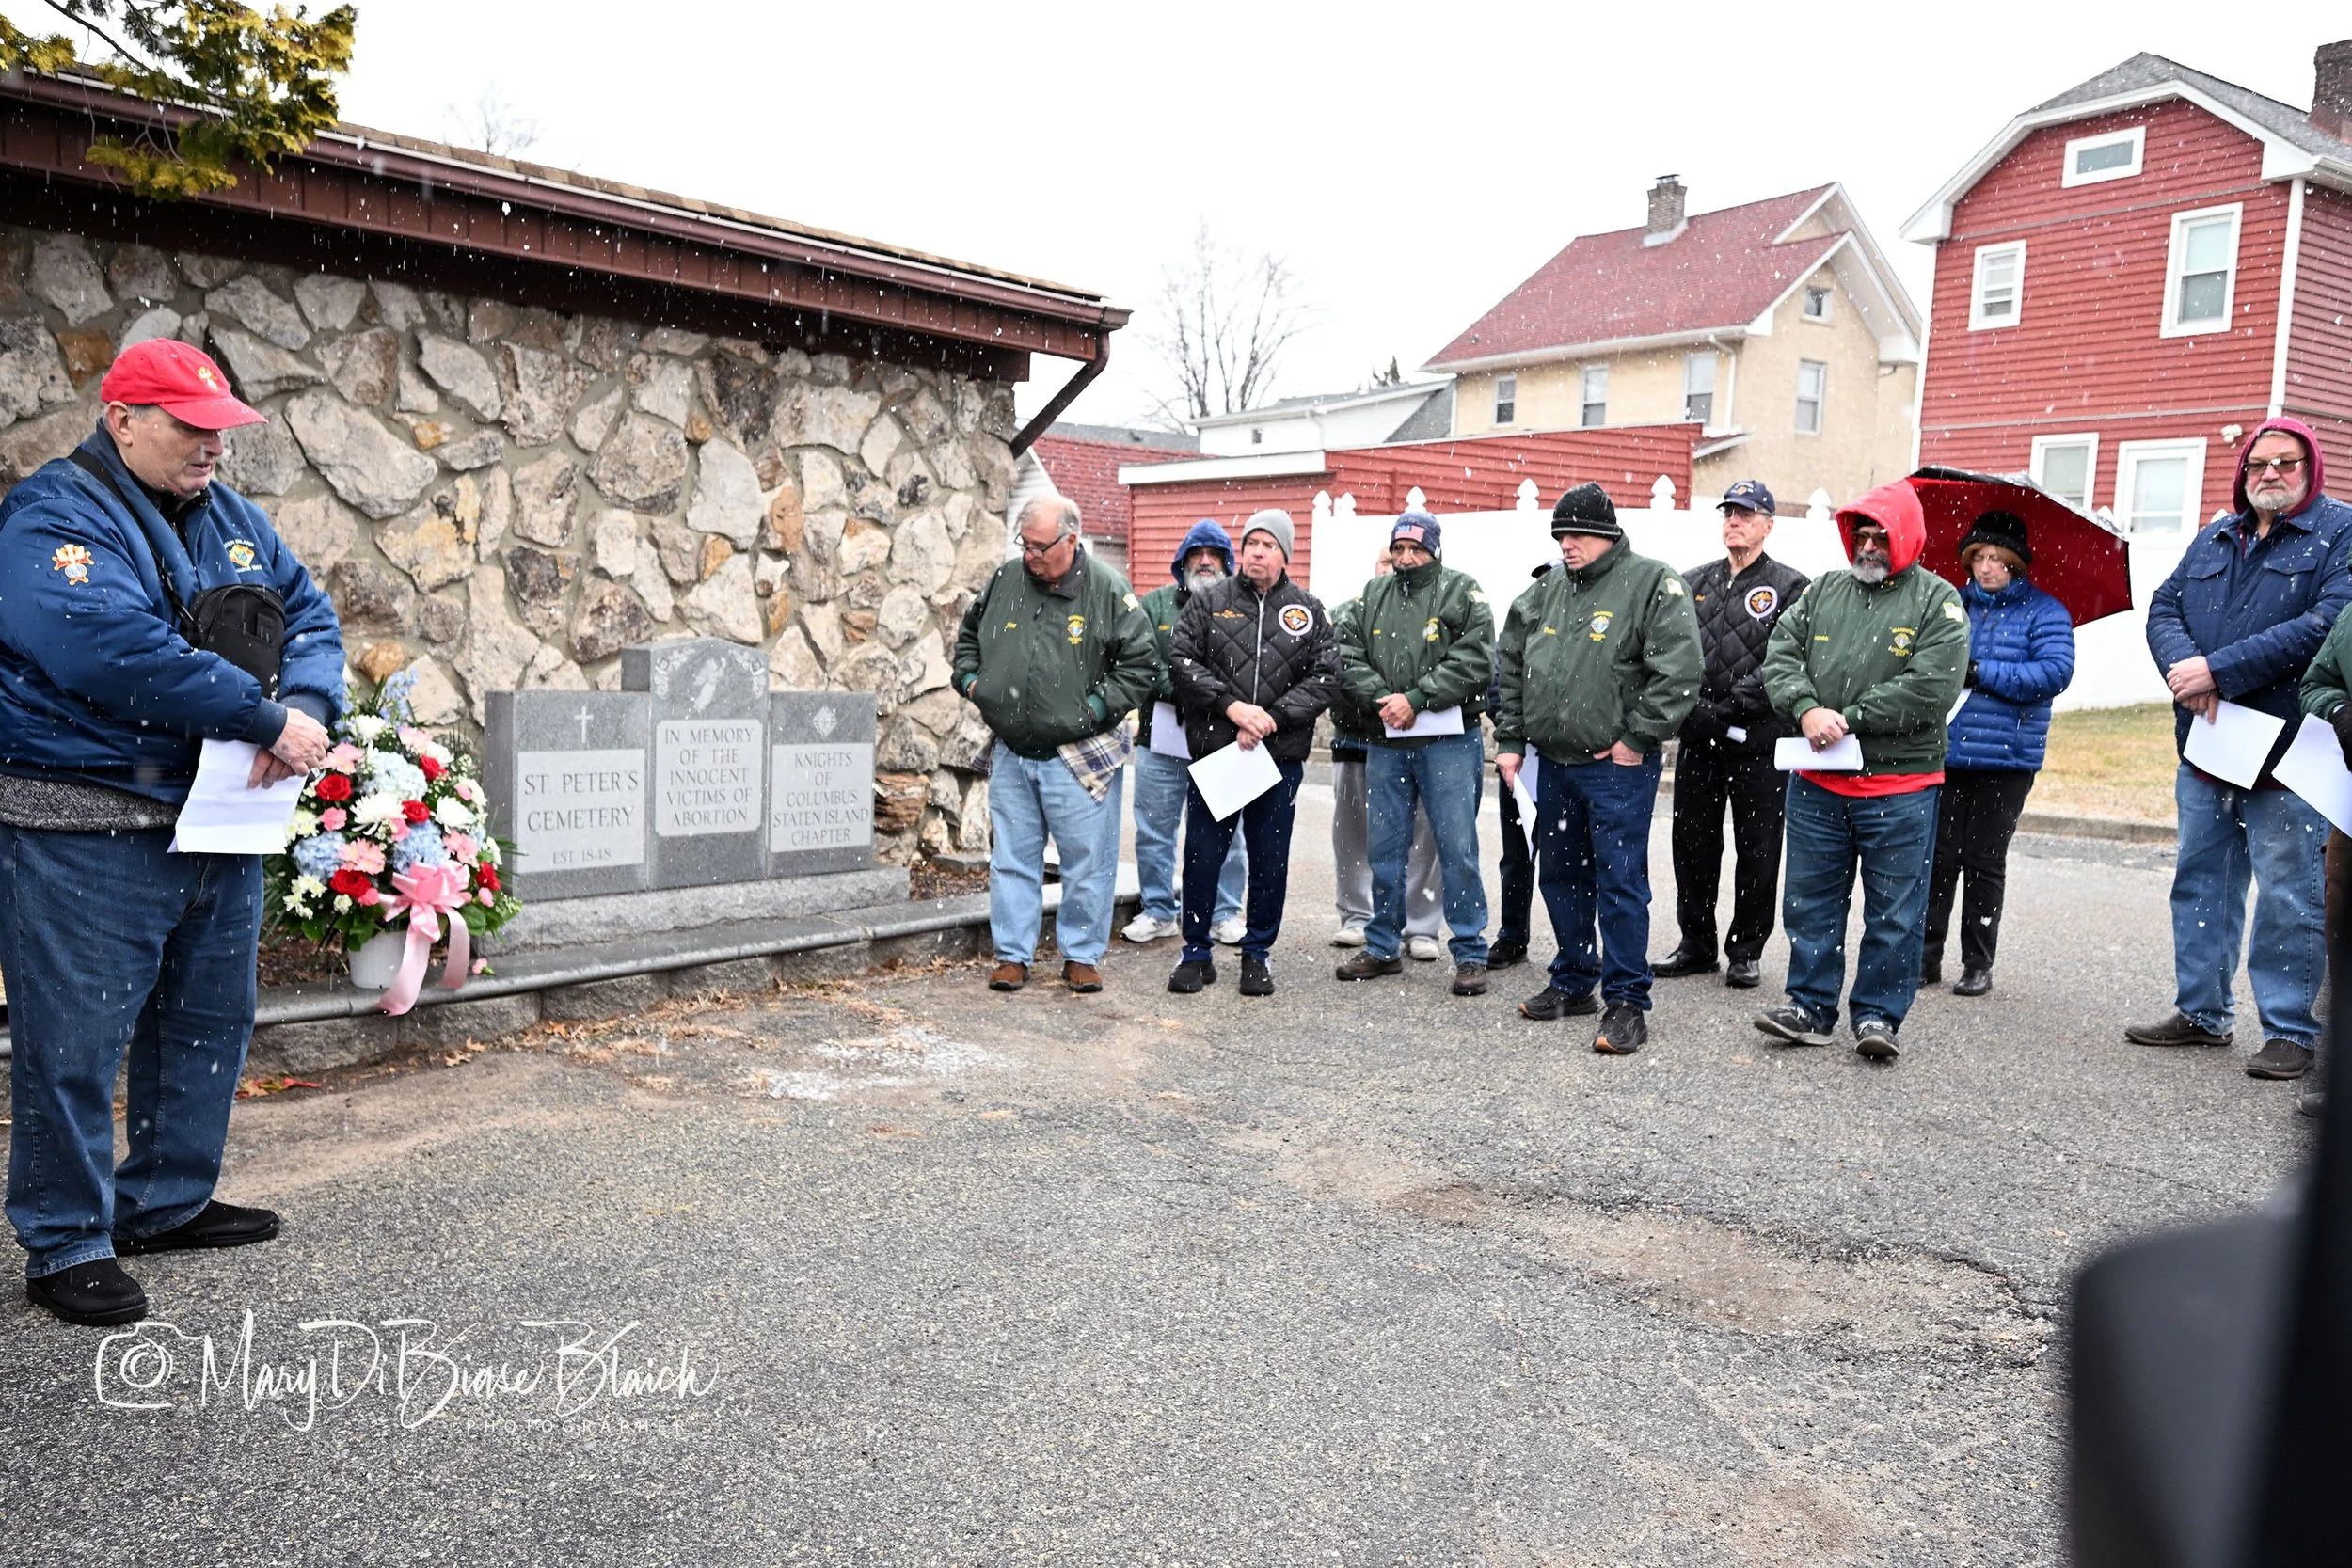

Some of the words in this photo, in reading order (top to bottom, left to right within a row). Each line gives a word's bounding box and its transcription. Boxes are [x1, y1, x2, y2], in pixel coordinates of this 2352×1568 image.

[665, 729, 680, 745] IN
[689, 727, 754, 744] MEMORY
[679, 749, 699, 766] OF
[712, 748, 739, 764] THE
[794, 752, 852, 768] KNIGHTS
[563, 771, 639, 793] PETER'S
[670, 768, 749, 786] INNOCENT
[815, 771, 832, 787] OF
[666, 789, 726, 806] VICTIMS
[734, 788, 753, 803] OF
[787, 790, 858, 808] COLUMBUS
[527, 806, 634, 832] CEMETERY
[672, 808, 748, 827] ABORTION
[773, 810, 820, 828] STATEN
[824, 808, 869, 825] ISLAND
[791, 828, 851, 847] CHAPTER
